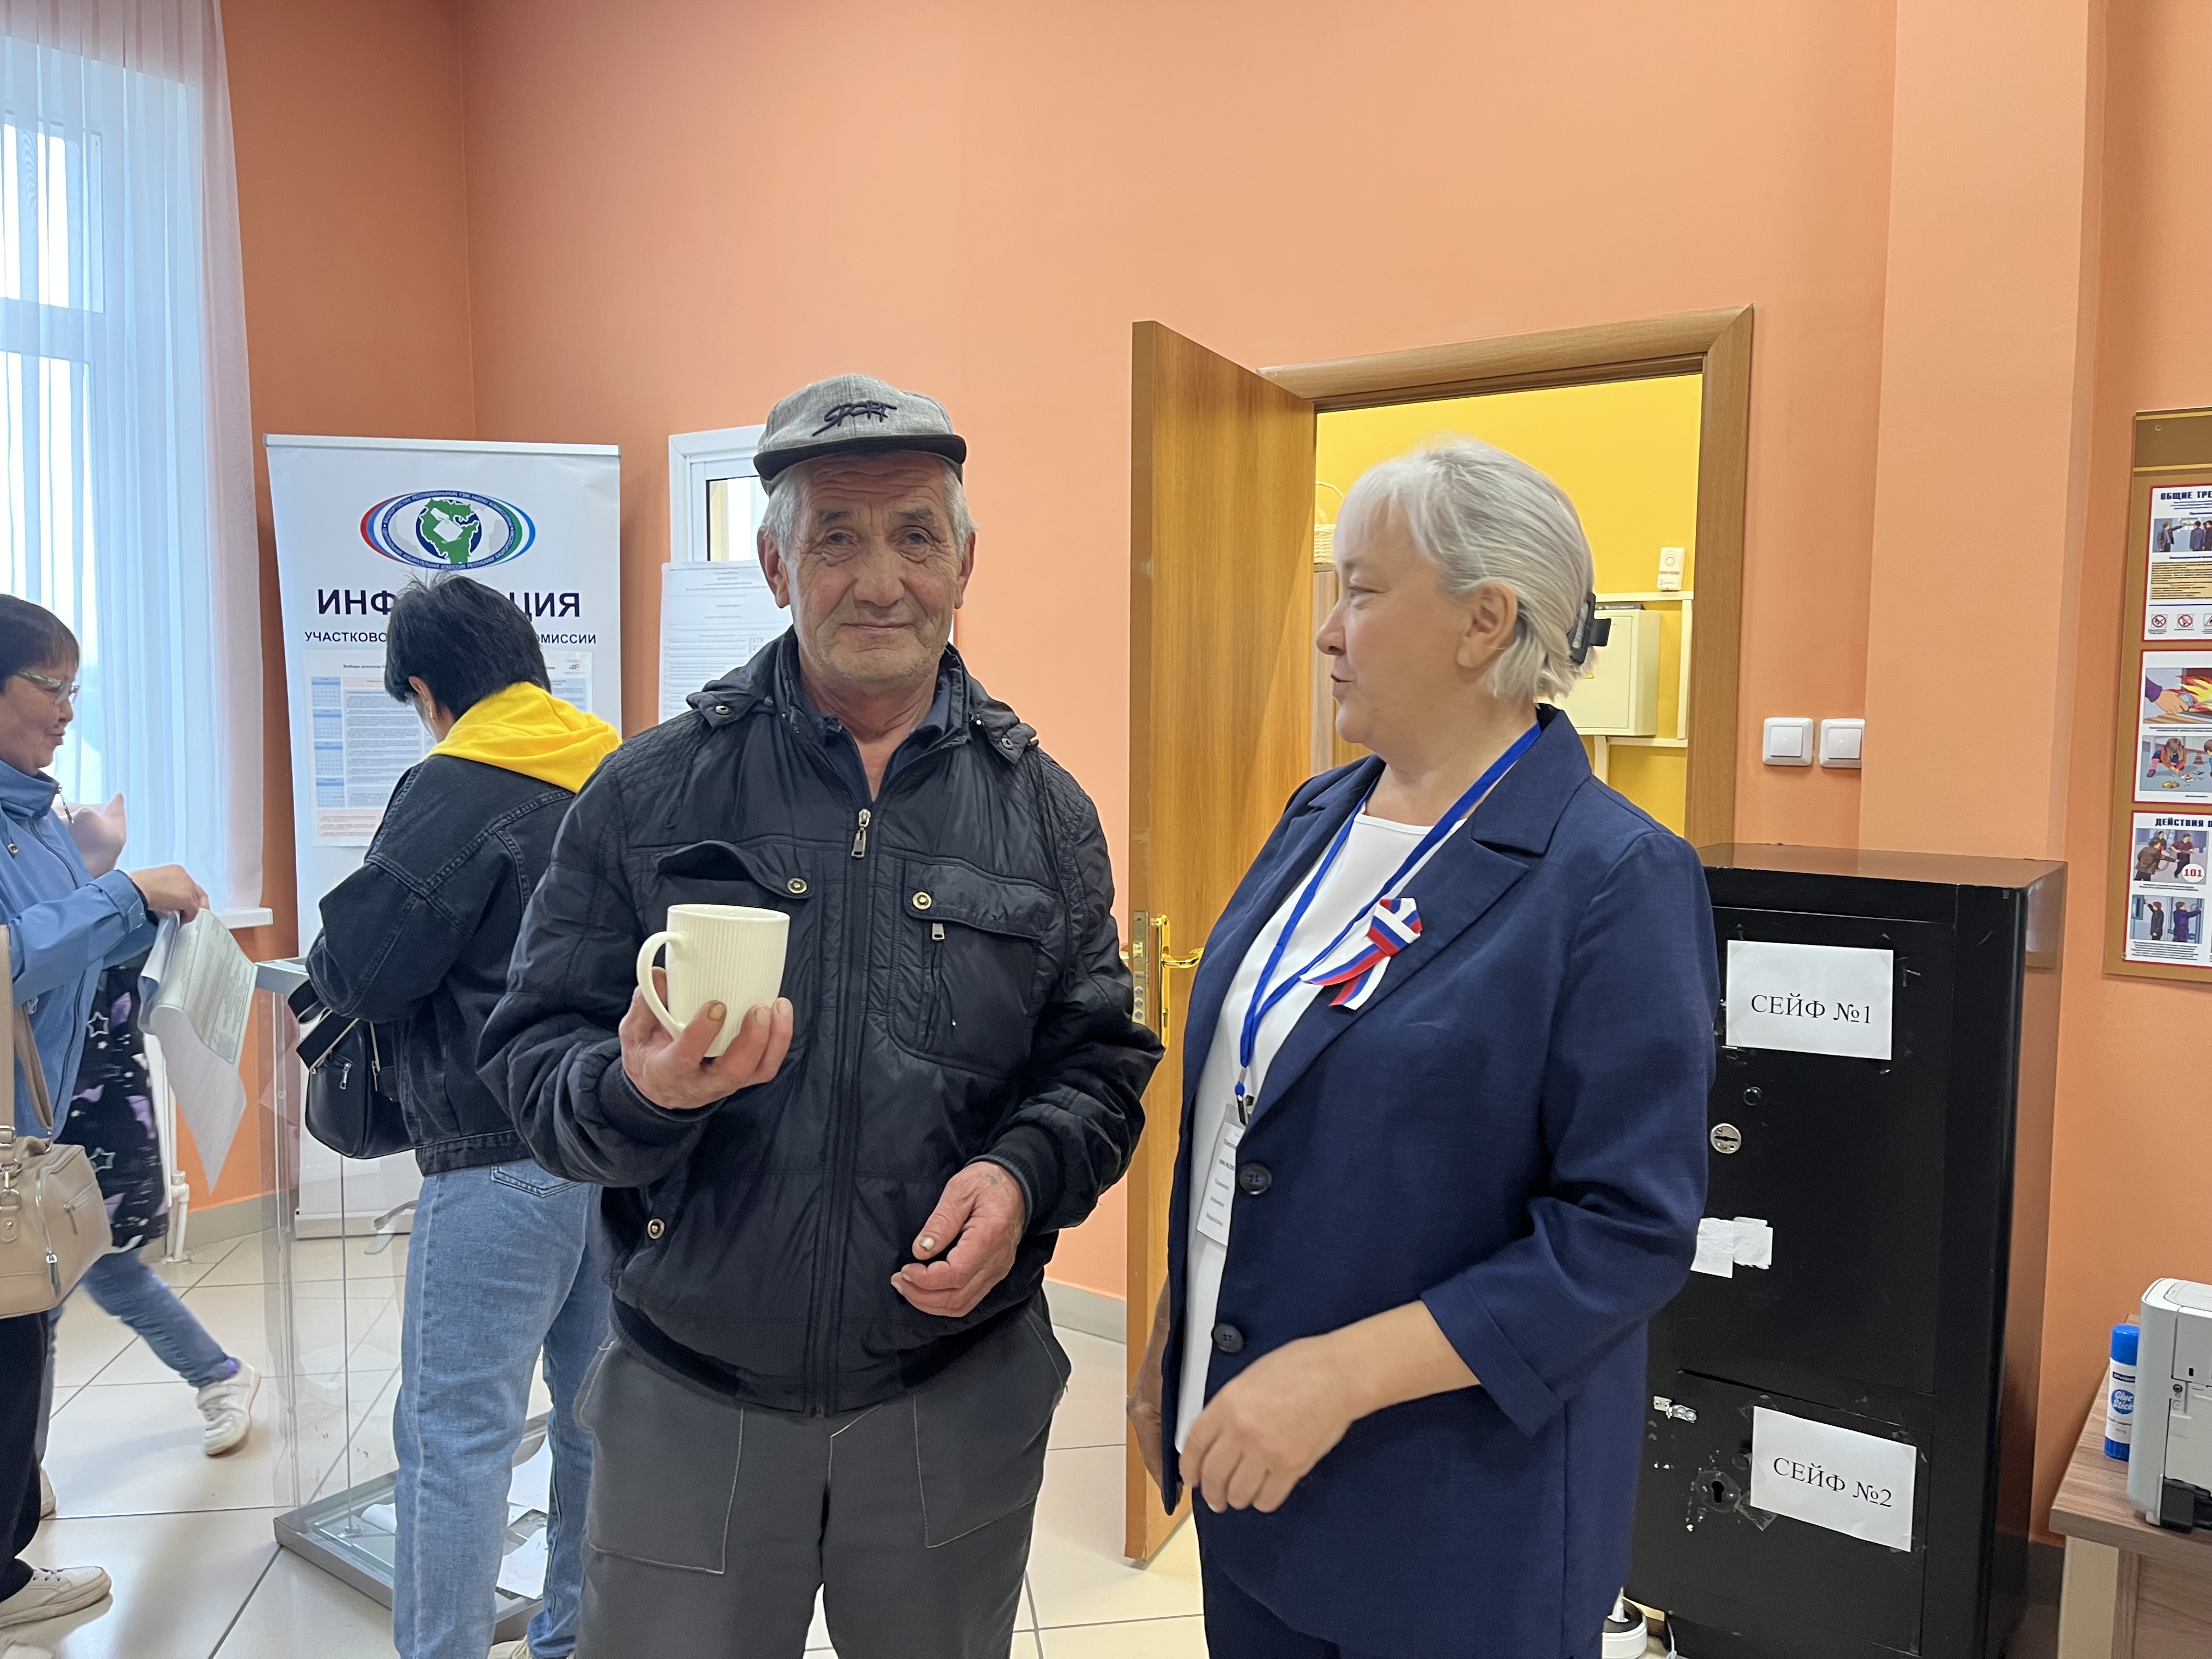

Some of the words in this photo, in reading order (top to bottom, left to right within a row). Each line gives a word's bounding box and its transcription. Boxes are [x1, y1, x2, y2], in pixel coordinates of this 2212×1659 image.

[2160, 491, 2193, 500] ОБЩИЕ
[318, 589, 580, 622] ИНФЦИЯ
[304, 631, 387, 642] УЧАСТКОВО
[537, 634, 596, 644] МИССИИ
[2155, 817, 2204, 827] ДЕЙСТВИЯ
[2183, 868, 2203, 877] 101
[1751, 992, 1826, 1019] СЕЙФ
[1833, 1002, 1871, 1024] №1
[2115, 1391, 2133, 1401] Glue
[2113, 1399, 2133, 1411] Stick
[1773, 1457, 1846, 1493] СЕЙФ
[1852, 1481, 1892, 1508] №2
